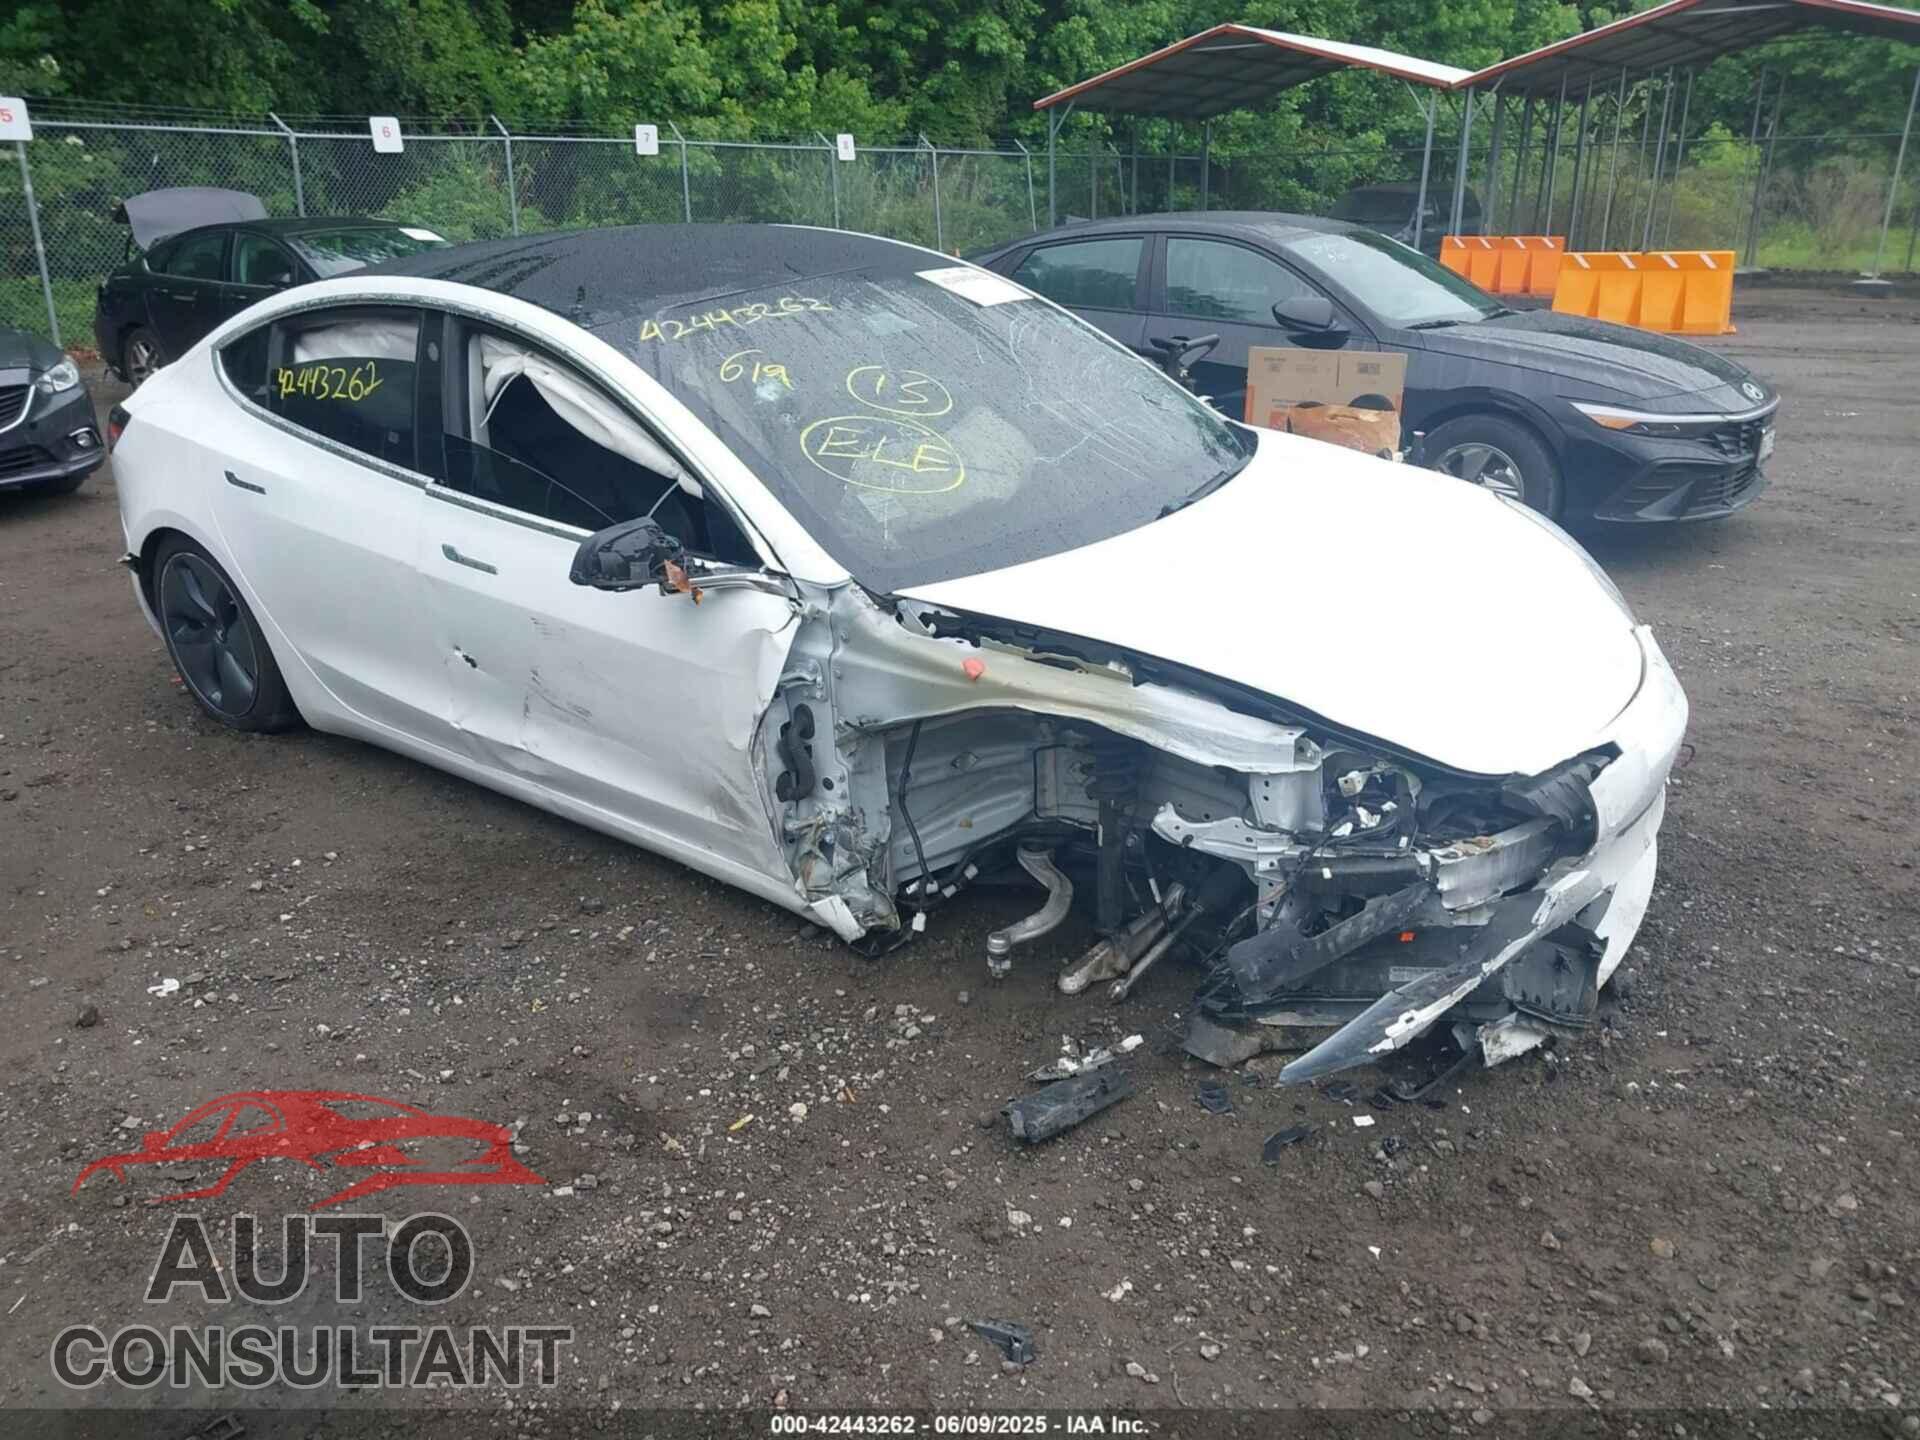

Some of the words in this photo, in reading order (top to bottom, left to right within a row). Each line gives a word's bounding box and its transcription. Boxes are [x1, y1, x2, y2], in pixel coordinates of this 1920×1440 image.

[0, 107, 13, 123] 5
[382, 126, 392, 138] 6
[278, 361, 384, 401] 42443262
[816, 426, 951, 472] ELE
